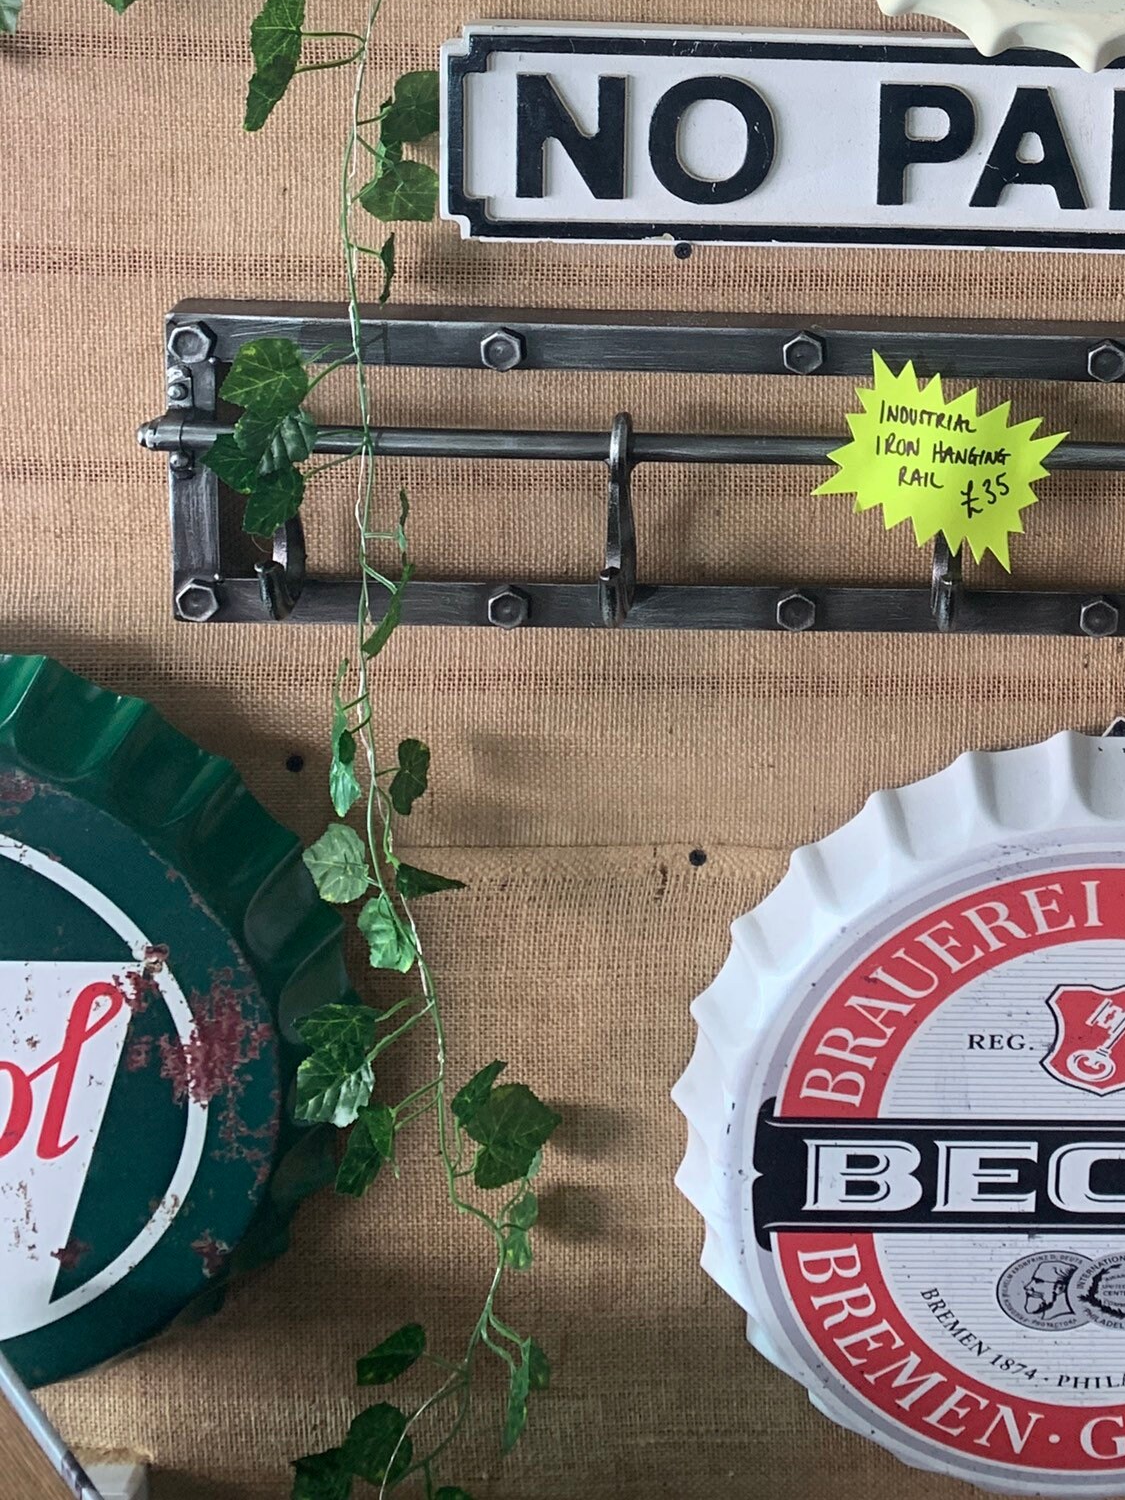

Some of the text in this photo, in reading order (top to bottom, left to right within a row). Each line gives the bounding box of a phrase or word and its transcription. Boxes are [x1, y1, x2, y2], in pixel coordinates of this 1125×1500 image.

[513, 71, 777, 207] NO
[875, 432, 1012, 467] IRON HANGING
[879, 399, 977, 434] INDUSTRIAL
[898, 465, 1010, 519] RAIL £35
[798, 878, 1103, 1108] BRAUEREI
[966, 1033, 1036, 1052] REG.
[796, 1242, 1046, 1455] BREMEN
[920, 1287, 992, 1357] BREMEN
[989, 1353, 1038, 1381] 1874
